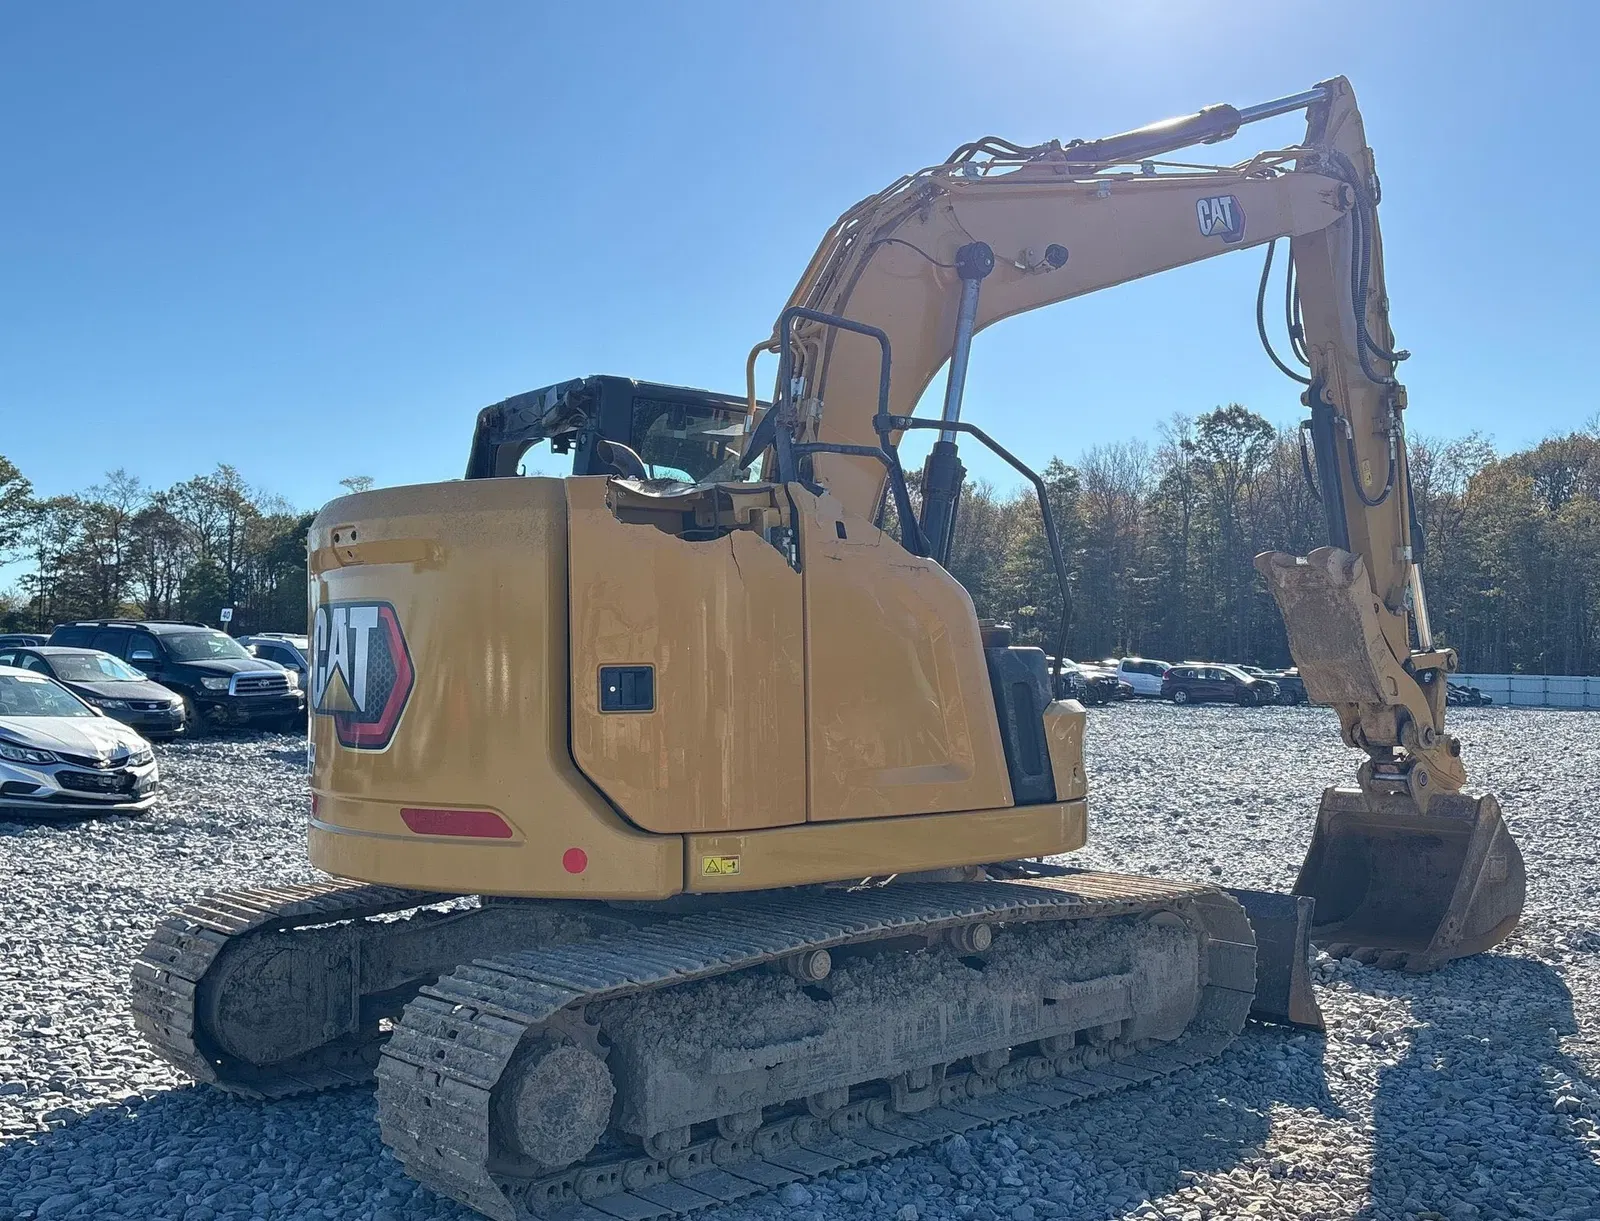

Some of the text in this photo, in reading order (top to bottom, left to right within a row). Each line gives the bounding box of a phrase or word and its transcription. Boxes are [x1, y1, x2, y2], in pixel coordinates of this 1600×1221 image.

[1197, 196, 1233, 235] CAT
[222, 611, 231, 619] 40
[313, 606, 378, 712] CAT
